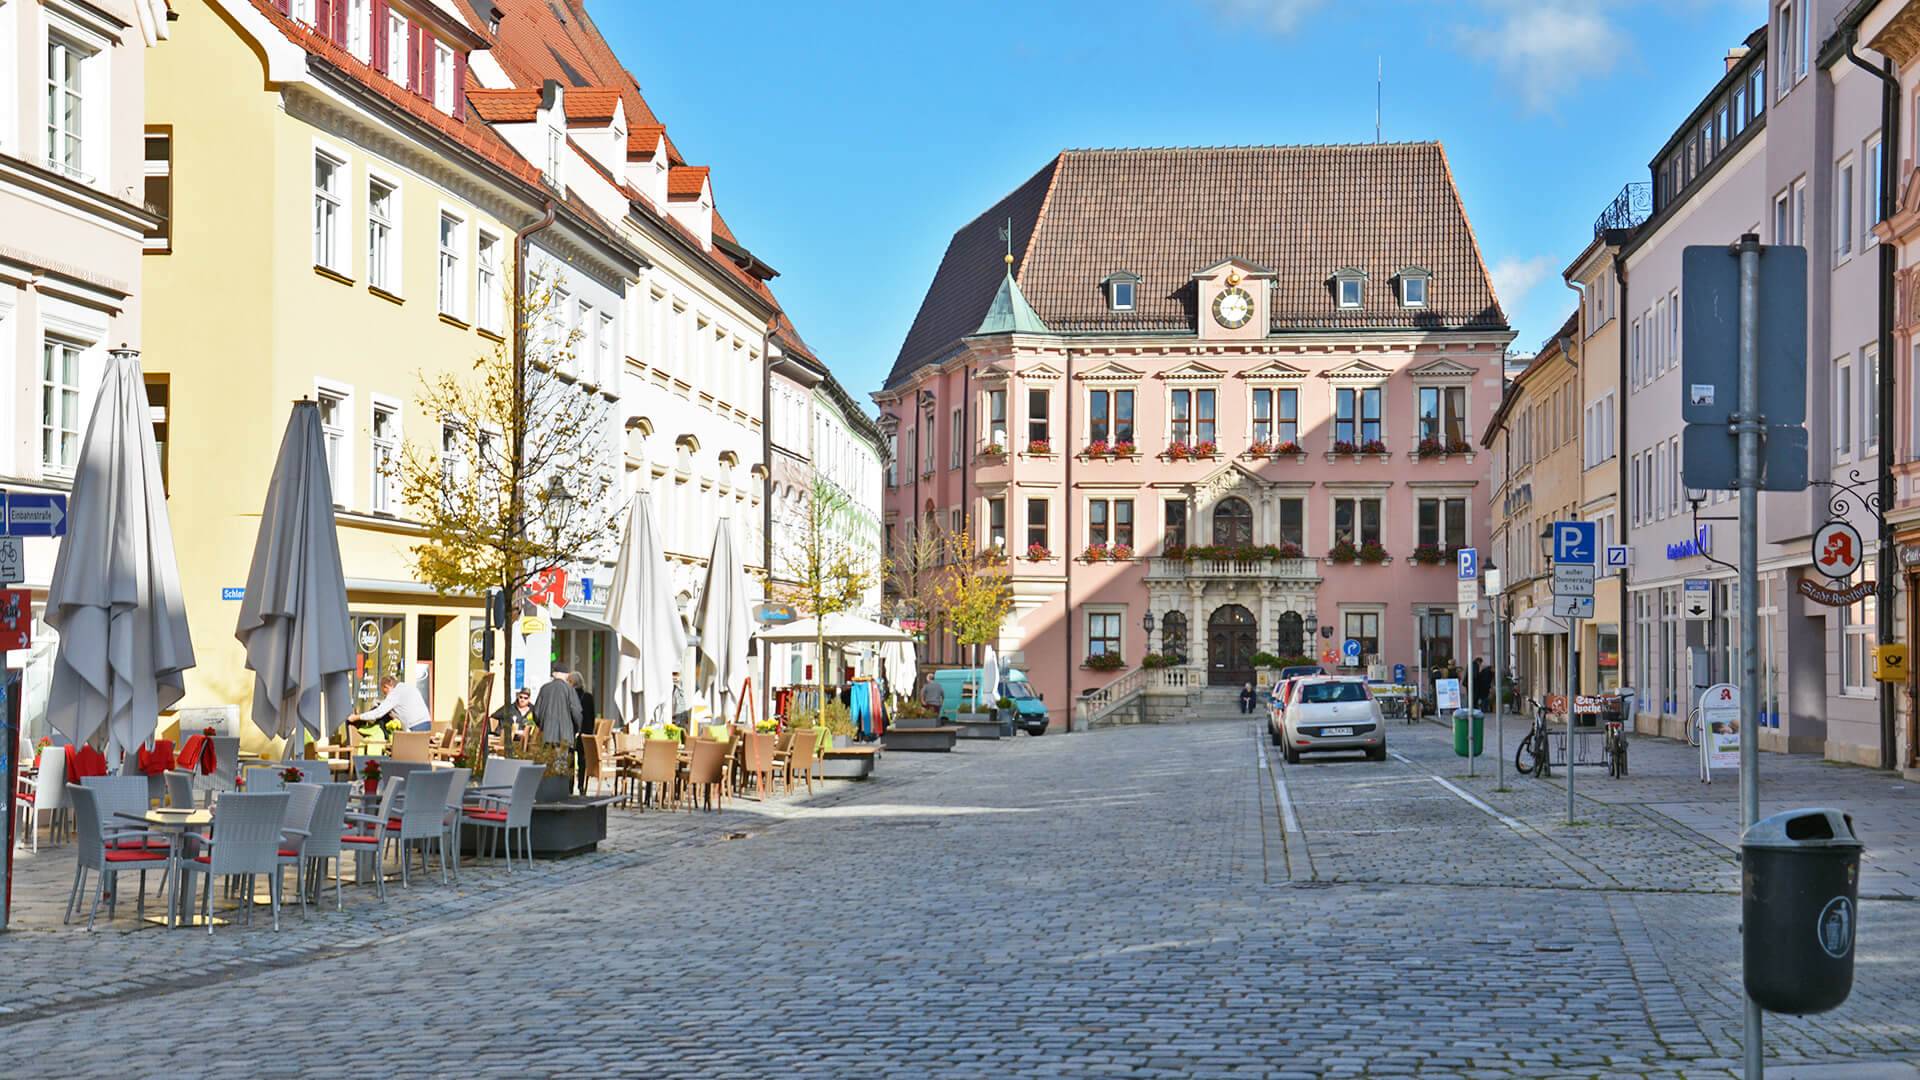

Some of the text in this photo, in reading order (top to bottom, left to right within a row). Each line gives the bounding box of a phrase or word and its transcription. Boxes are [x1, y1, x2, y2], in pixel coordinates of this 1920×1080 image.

[1561, 527, 1582, 559] P
[1460, 552, 1472, 576] P
[1556, 577, 1593, 585] Donnerstag
